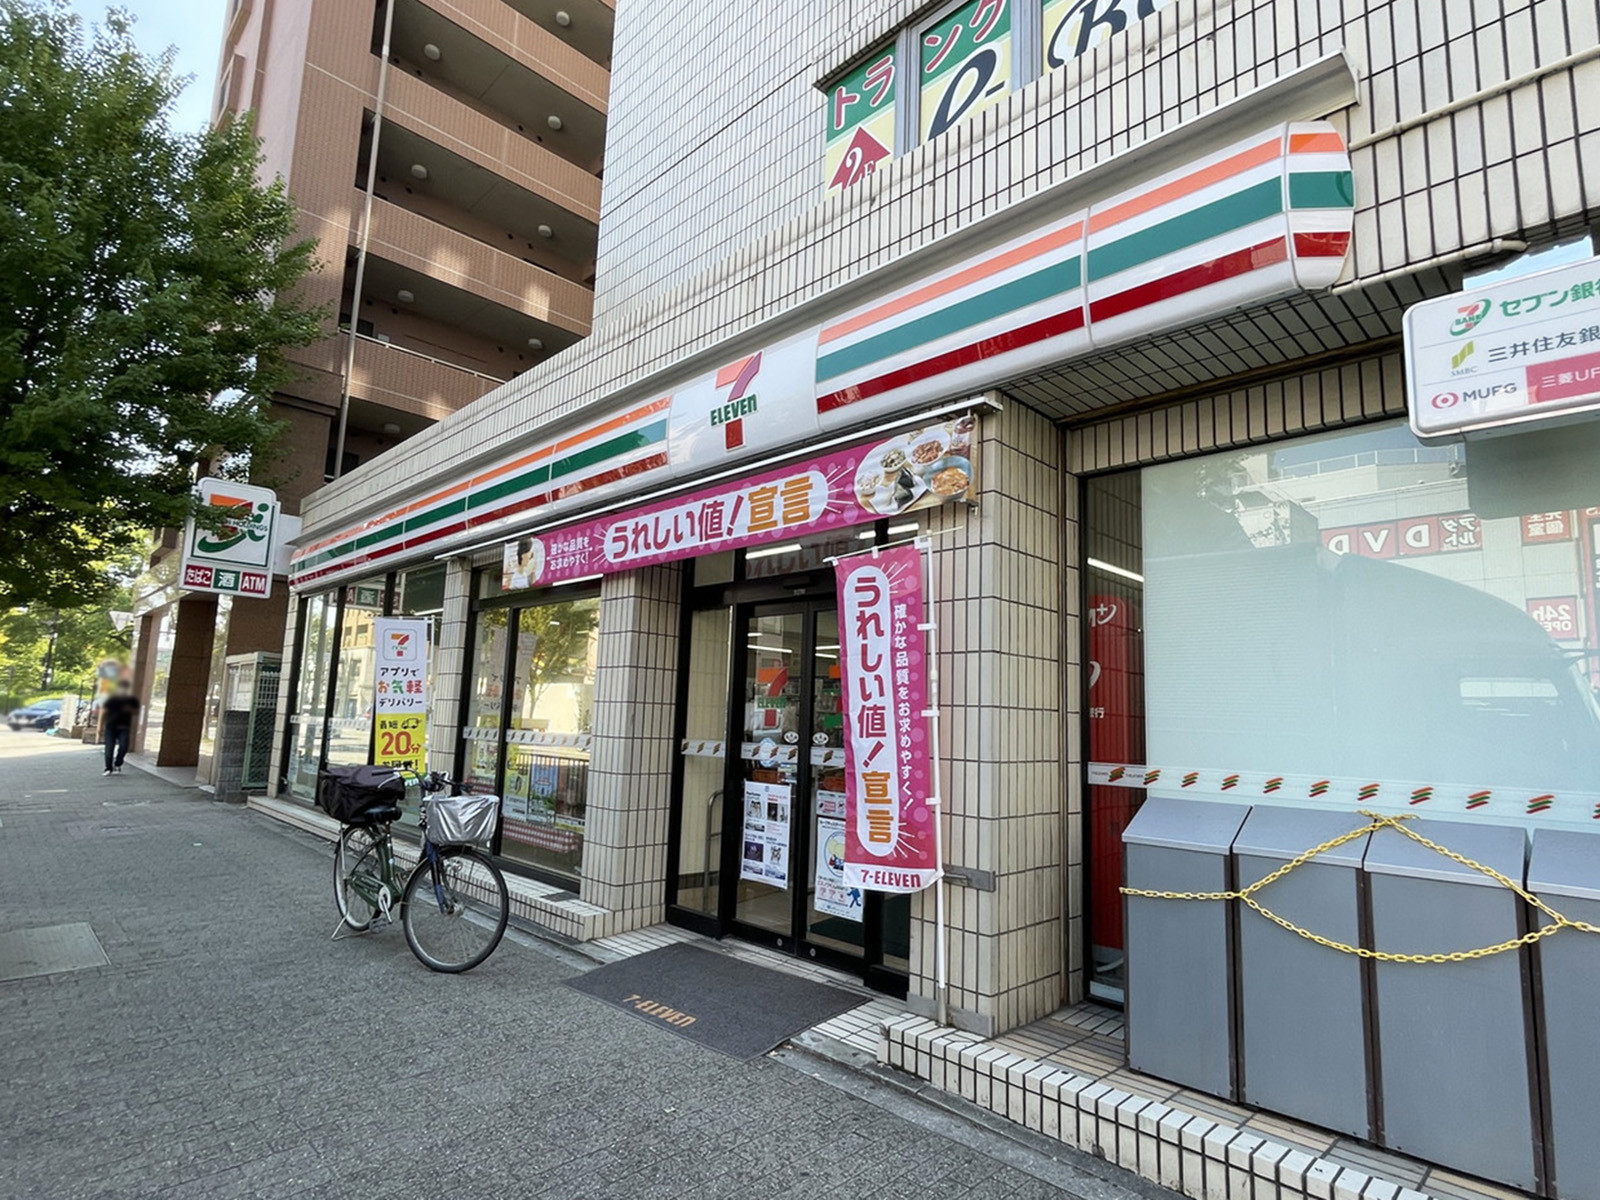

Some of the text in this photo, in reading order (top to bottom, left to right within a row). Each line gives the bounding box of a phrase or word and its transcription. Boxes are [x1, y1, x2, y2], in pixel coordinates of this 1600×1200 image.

[1451, 366, 1478, 376] SMBC
[1462, 382, 1518, 402] MUFG
[186, 567, 266, 592] たばこ 酒 ATM
[380, 667, 419, 677] アプリで
[378, 680, 423, 694] お気軽
[379, 697, 423, 707] デリバリー
[381, 731, 421, 756] 20分
